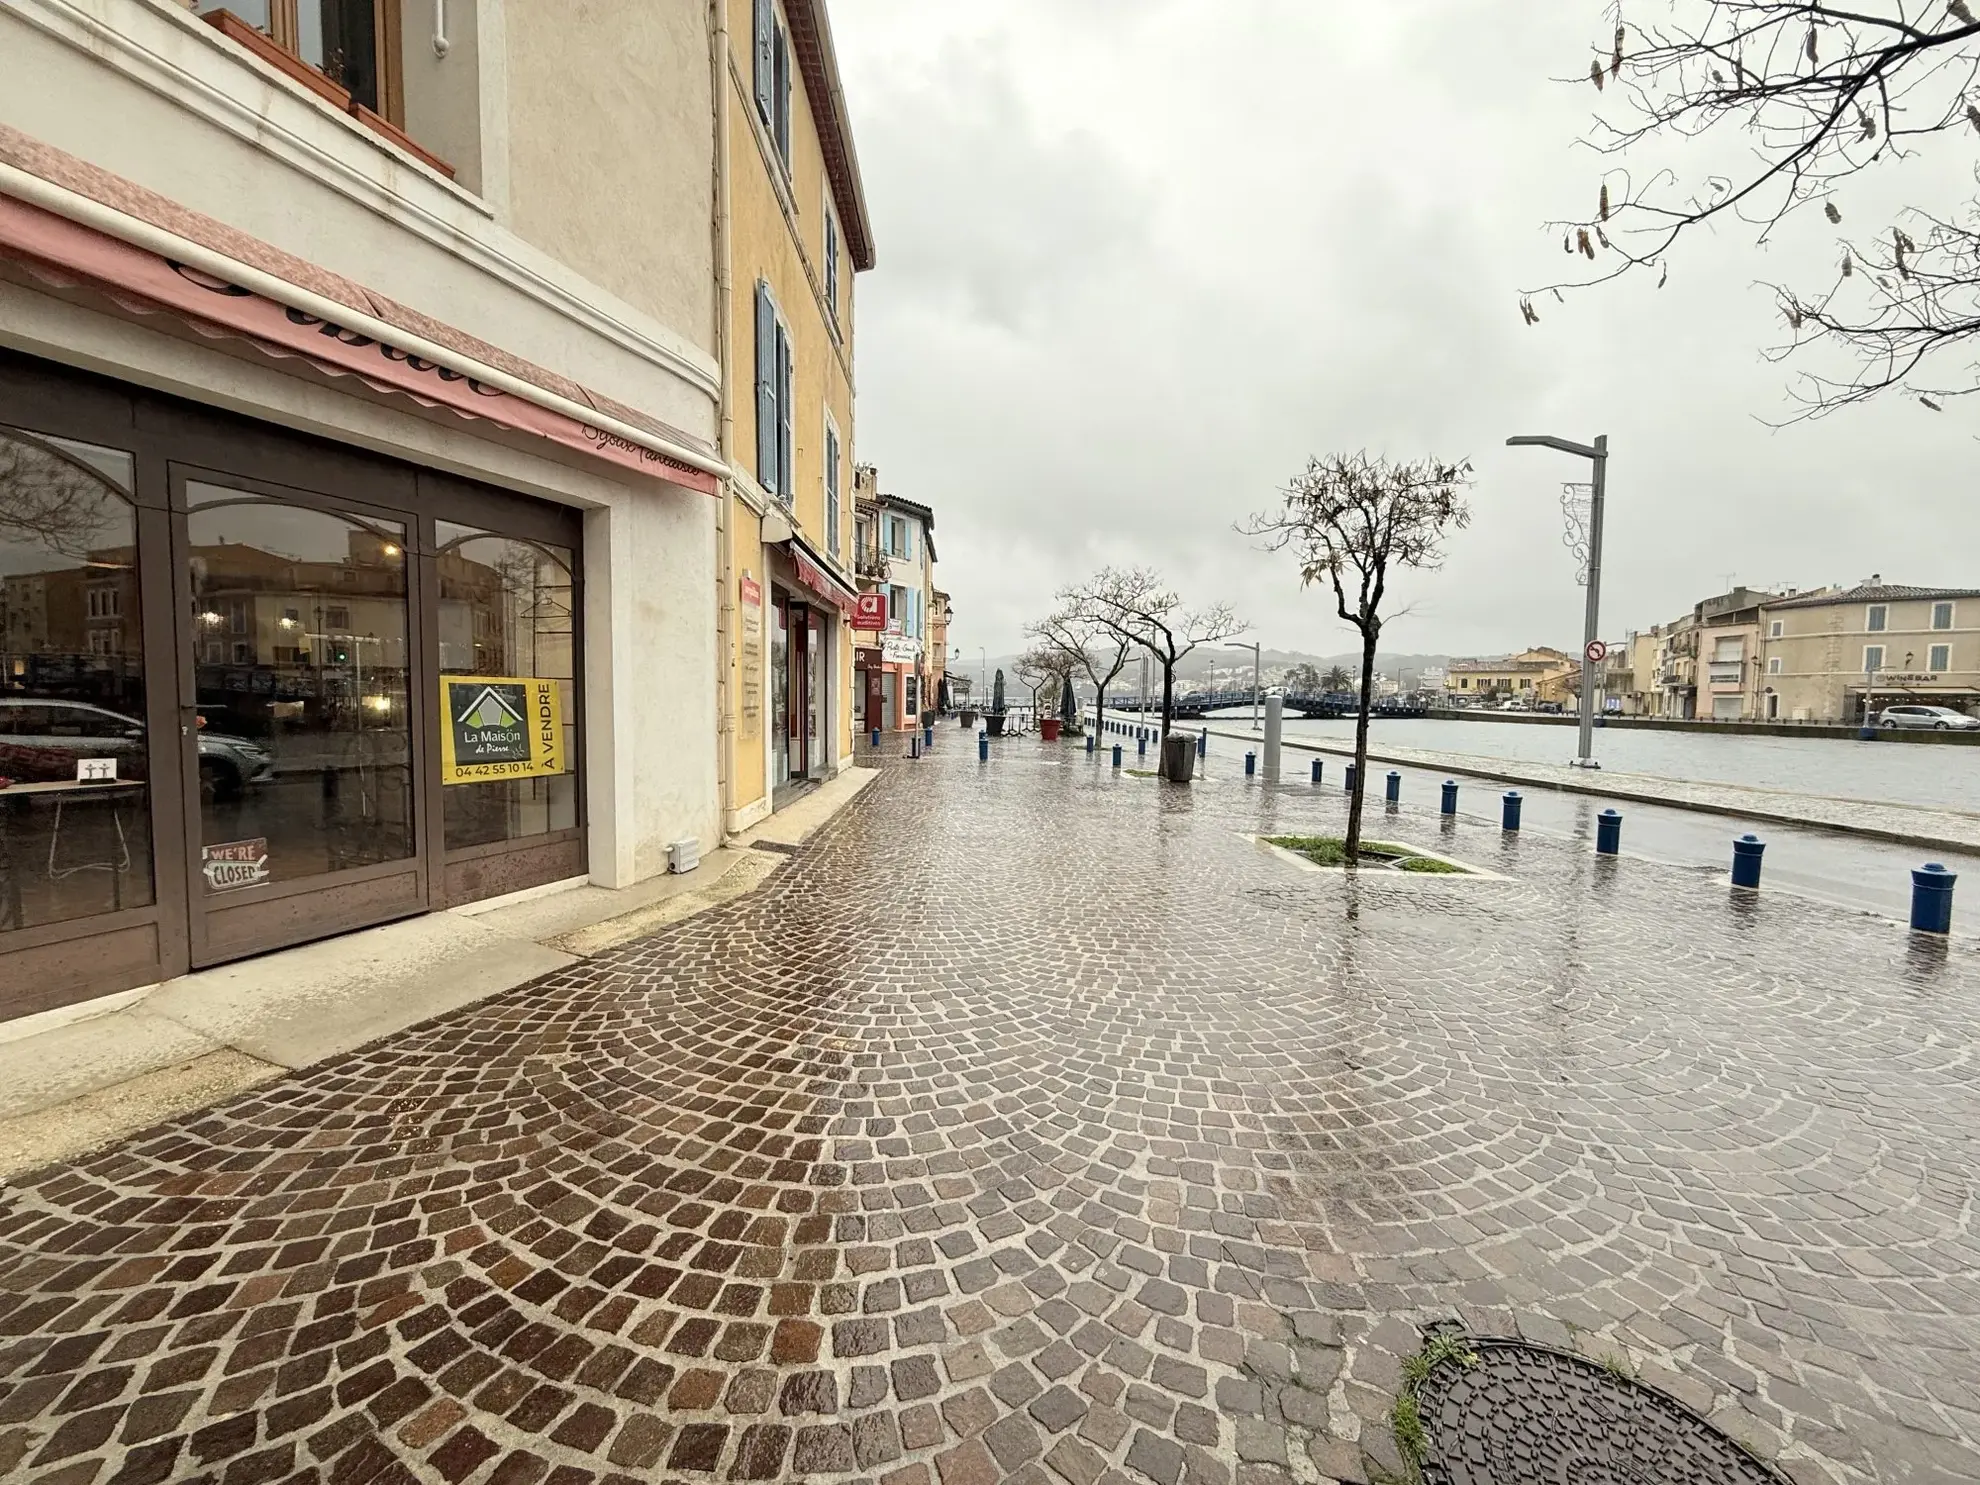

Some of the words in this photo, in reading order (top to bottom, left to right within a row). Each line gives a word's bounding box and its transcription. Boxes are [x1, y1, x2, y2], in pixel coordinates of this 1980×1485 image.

[538, 683, 554, 754] VENDRE
[464, 731, 478, 743] La
[475, 744, 485, 754] de
[455, 767, 472, 778] 04
[475, 765, 490, 776] 42
[492, 764, 506, 775] 55
[508, 763, 520, 773] 10
[522, 762, 534, 771] 14
[211, 845, 256, 860] WE'RE
[213, 865, 256, 884] CLOSED
